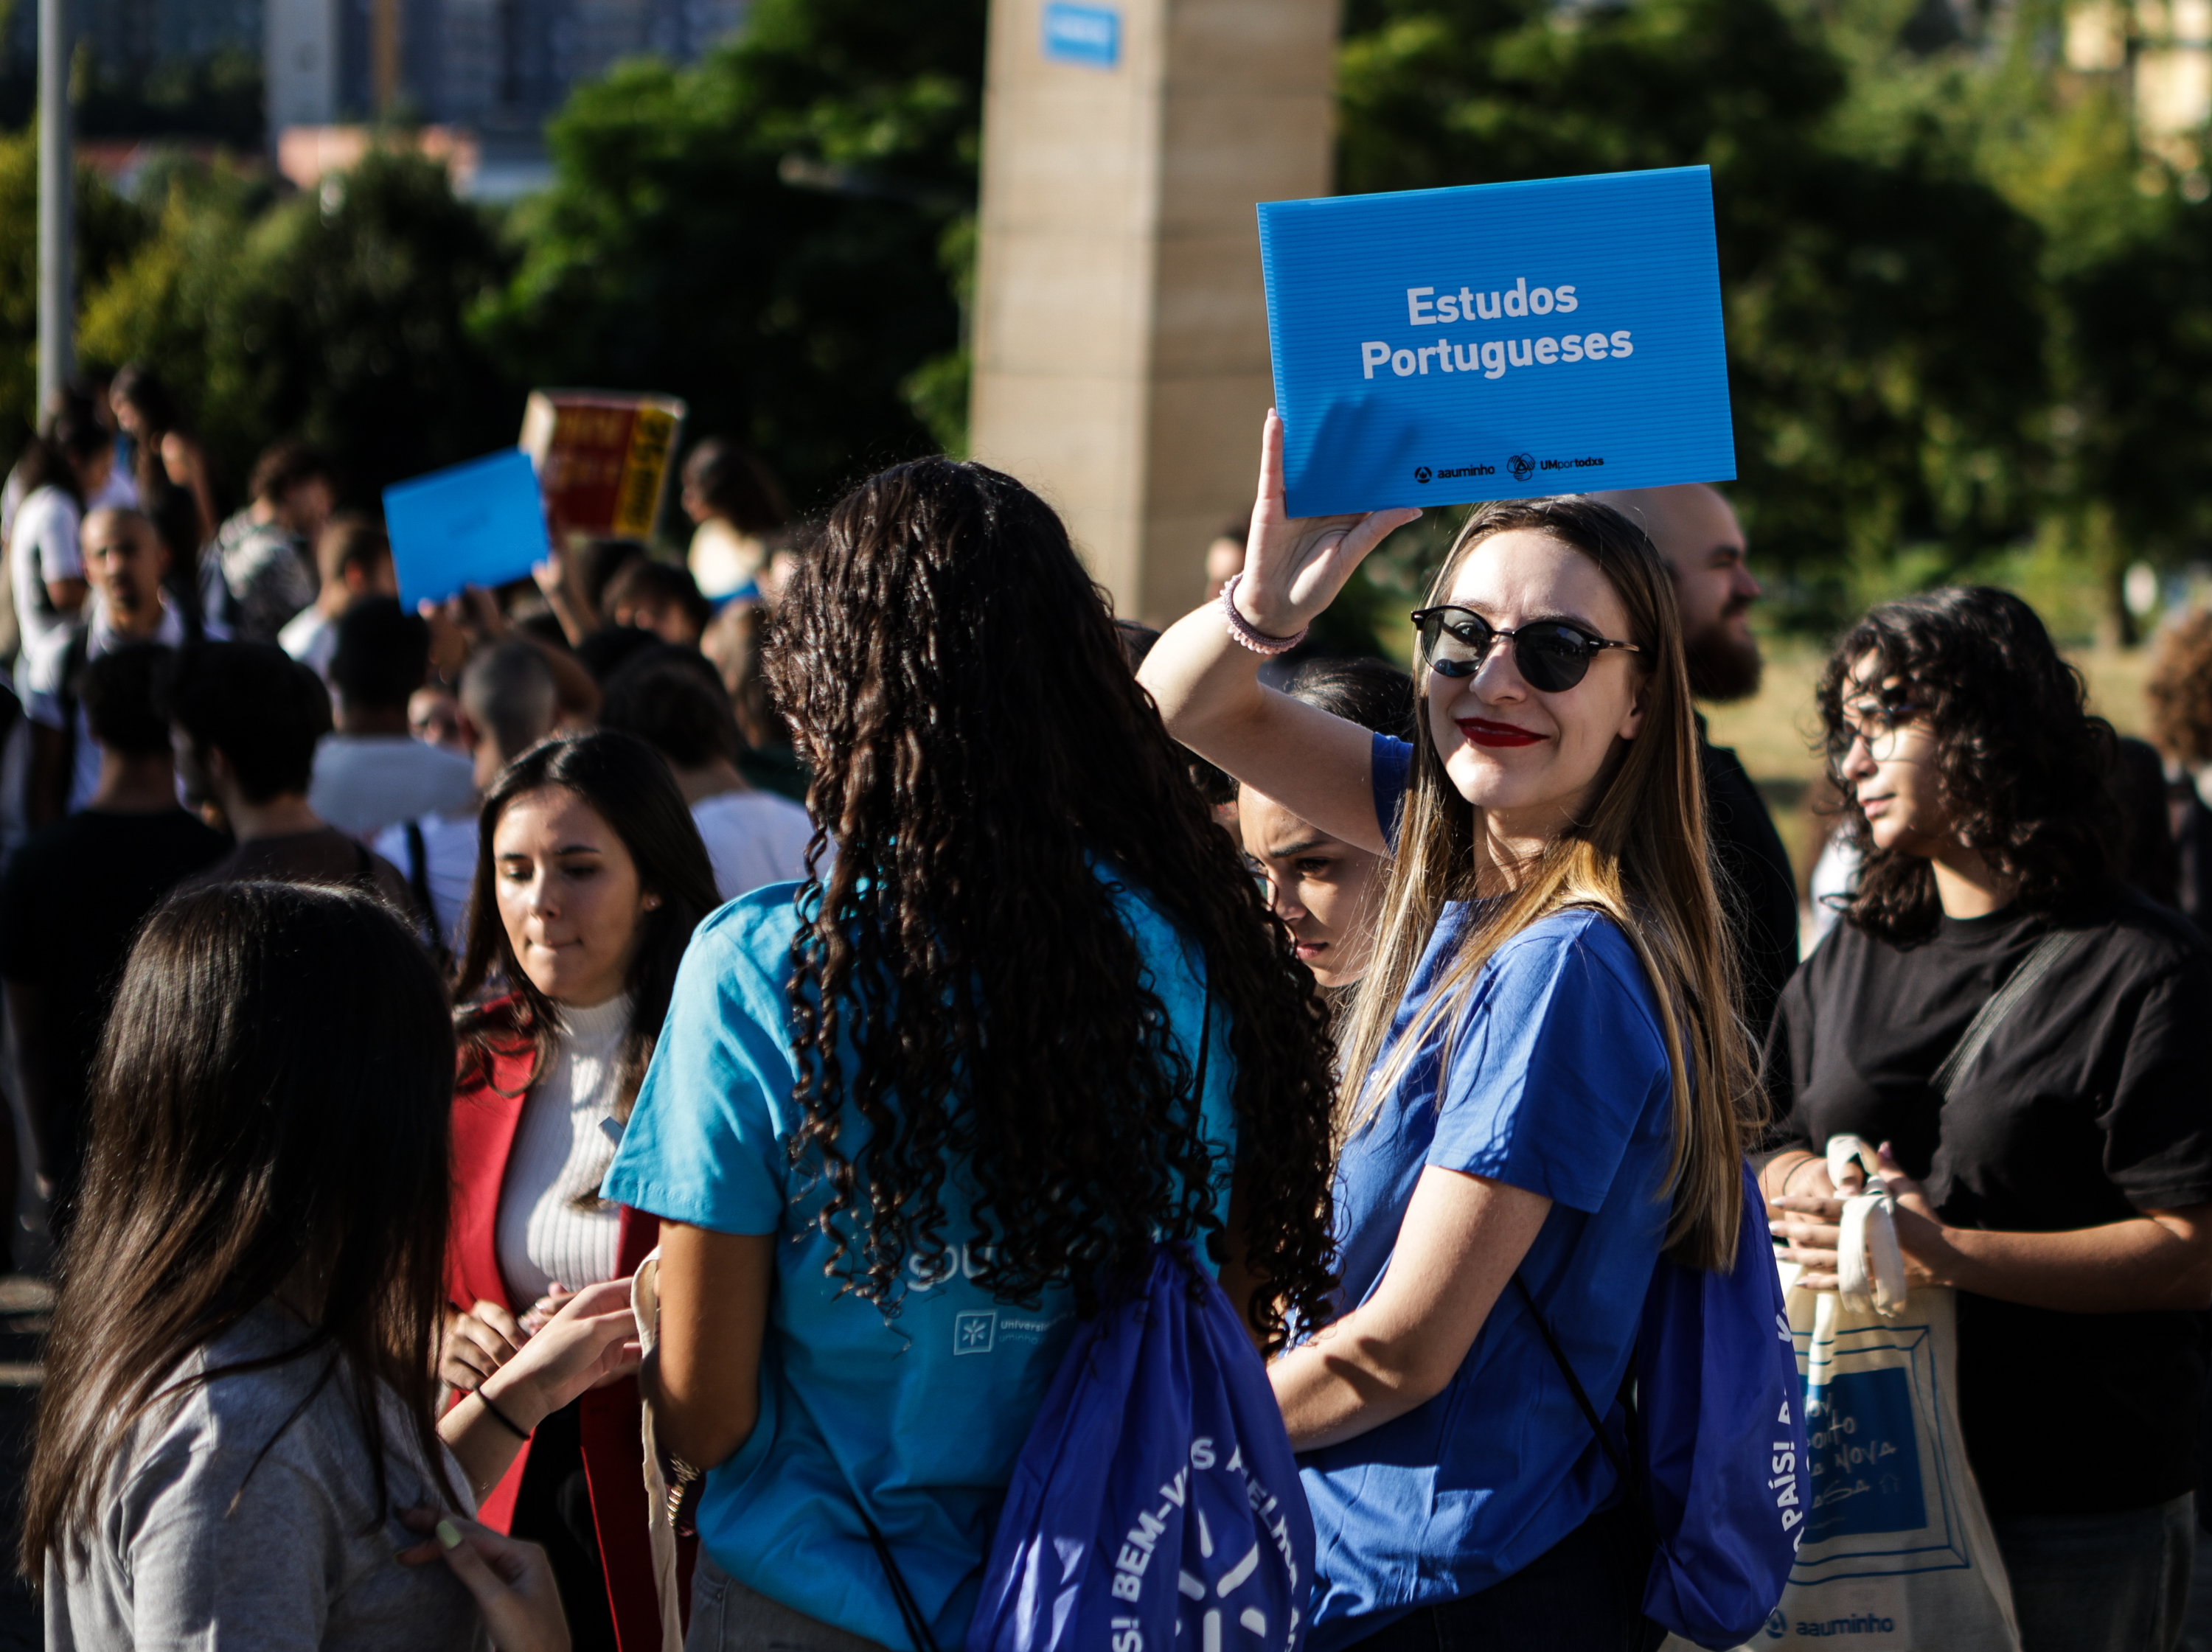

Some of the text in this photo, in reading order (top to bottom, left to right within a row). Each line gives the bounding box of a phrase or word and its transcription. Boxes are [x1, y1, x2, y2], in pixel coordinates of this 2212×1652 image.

[1407, 277, 1579, 326] Estudos
[1361, 330, 1634, 380] Portugueses
[1438, 464, 1495, 479] aauminho
[1540, 456, 1604, 471] UMportodxs
[1769, 1441, 1804, 1532] PAÍS!
[1796, 1613, 1894, 1637] aauminho
